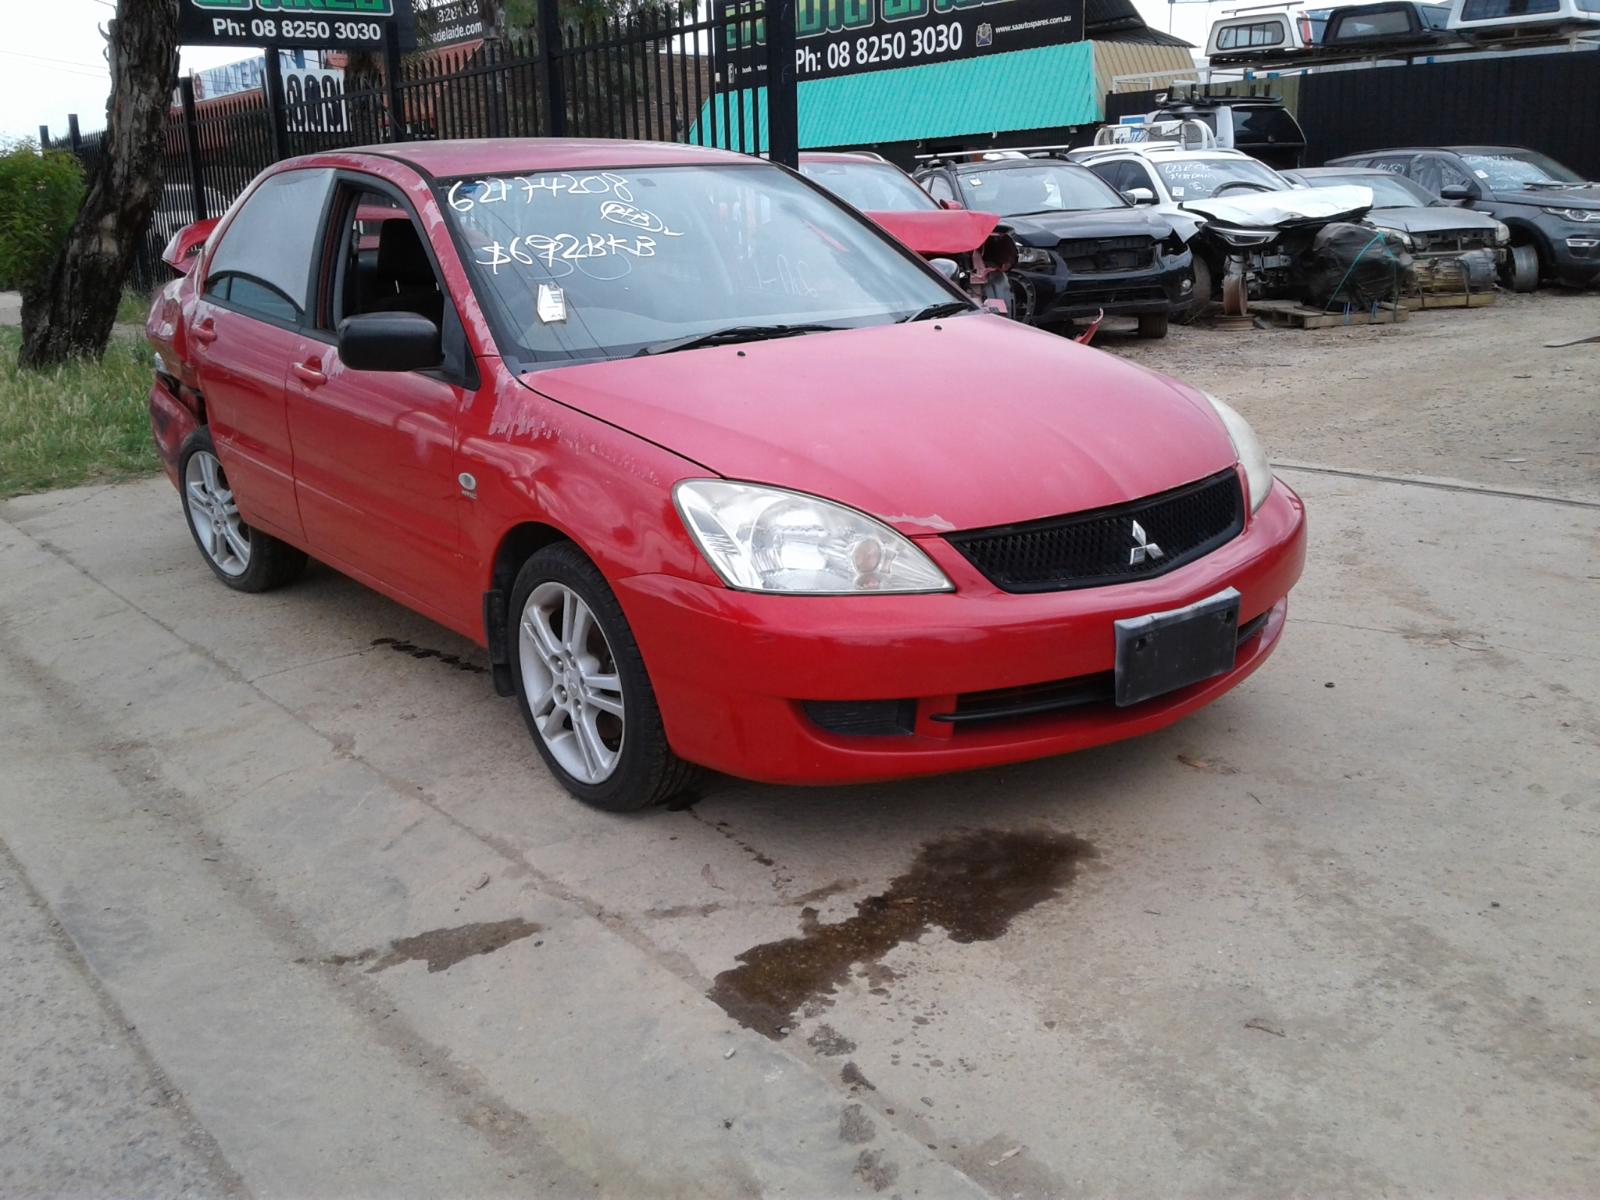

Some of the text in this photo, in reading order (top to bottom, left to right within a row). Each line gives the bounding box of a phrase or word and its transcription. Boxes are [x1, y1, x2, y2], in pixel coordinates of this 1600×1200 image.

[212, 18, 381, 40] Ph: 08 8250 3030
[796, 44, 821, 74] Ph:
[827, 41, 850, 69] 08
[856, 31, 905, 63] 8250
[910, 21, 962, 57] 3030
[995, 15, 1072, 34] www.saautospares.com.au
